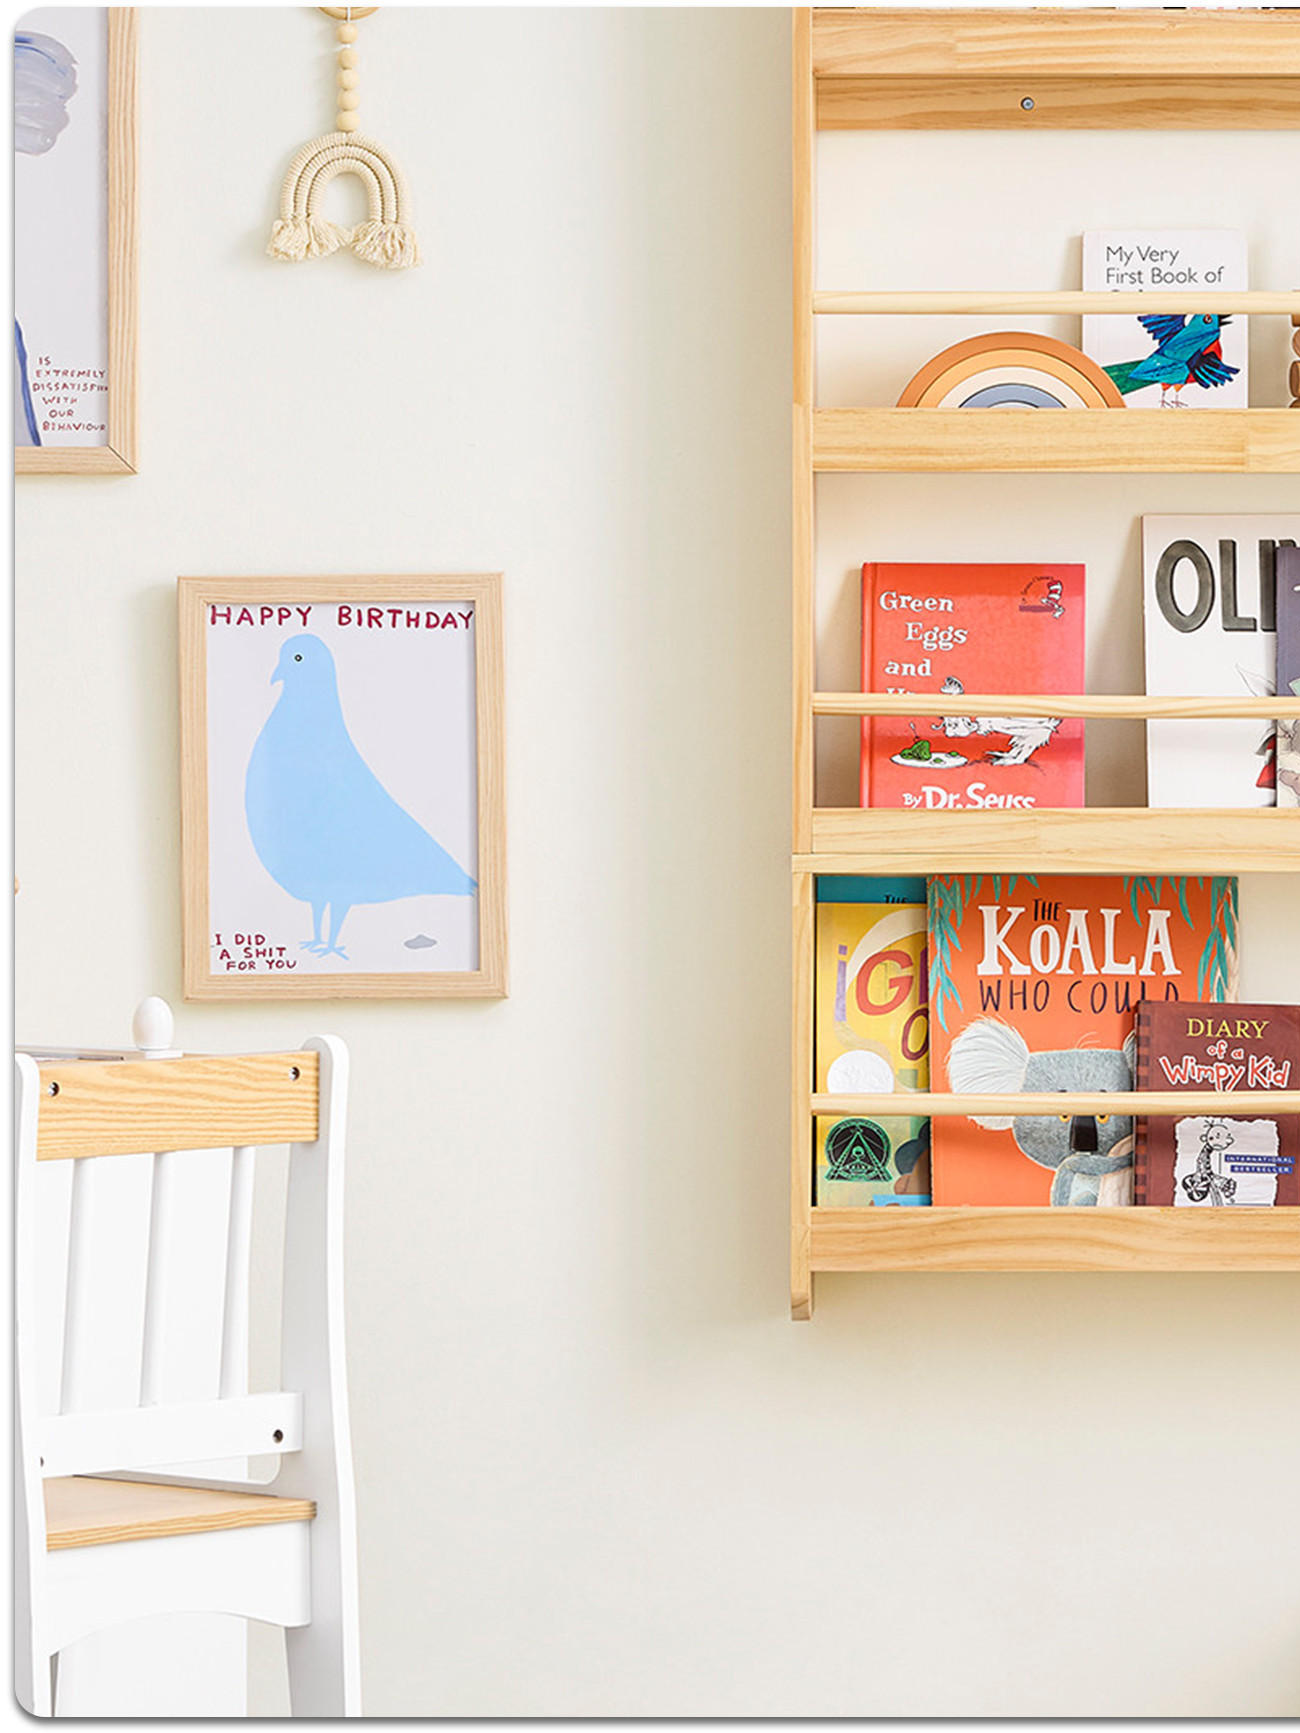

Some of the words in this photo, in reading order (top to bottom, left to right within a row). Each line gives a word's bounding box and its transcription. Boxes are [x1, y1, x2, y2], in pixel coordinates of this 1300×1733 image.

[1105, 246, 1134, 266] My
[1136, 246, 1180, 266] Very
[1105, 267, 1144, 284] First
[1150, 267, 1199, 284] Book
[1204, 266, 1225, 284] of
[38, 356, 51, 366] IS
[42, 396, 78, 404] WITH
[48, 409, 74, 418] OUR
[42, 420, 106, 431] BEHAVIOUR
[879, 591, 954, 612] Green
[210, 605, 312, 626] HAPPY
[337, 605, 474, 629] BIRTHDAY
[904, 622, 968, 651] Eggs
[884, 658, 932, 677] and
[902, 792, 922, 808] By
[1032, 898, 1062, 922] THE
[215, 933, 222, 946] I
[234, 933, 266, 946] DID
[219, 948, 231, 960] A
[243, 946, 287, 958] SHIT
[226, 960, 256, 971] FOR
[265, 959, 297, 970] YOU
[979, 979, 1050, 1012] WHO
[1186, 1017, 1270, 1039] DIARY
[1206, 1039, 1228, 1059] of
[1231, 1048, 1244, 1060] a
[1158, 1055, 1245, 1092] Wimpy
[1248, 1055, 1291, 1089] Kid
